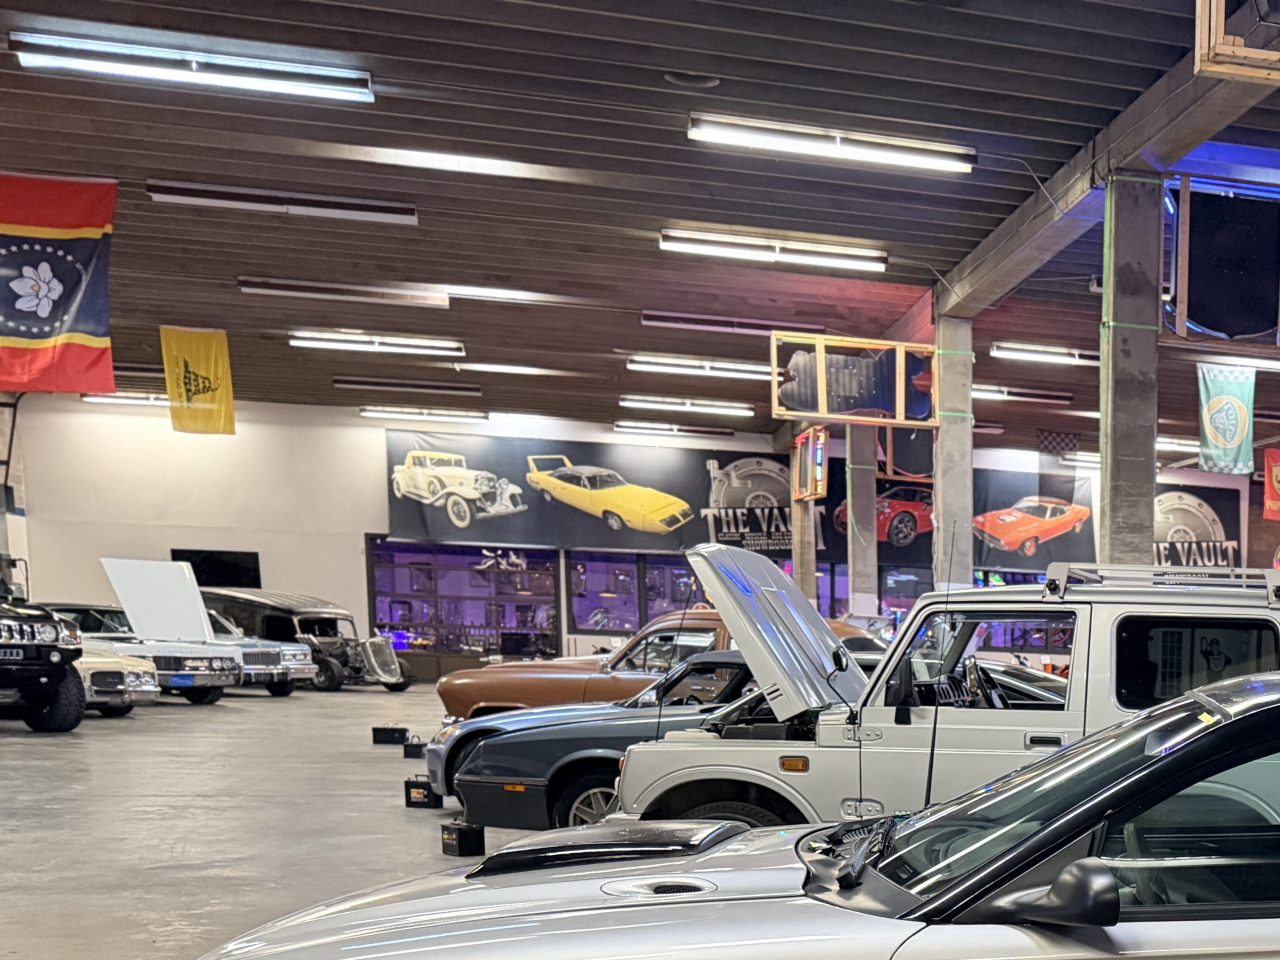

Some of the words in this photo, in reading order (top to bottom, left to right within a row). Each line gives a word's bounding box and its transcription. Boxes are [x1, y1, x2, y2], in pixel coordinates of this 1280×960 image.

[700, 507, 750, 543] THE
[755, 505, 826, 550] VAT
[1174, 540, 1238, 579] VAULT
